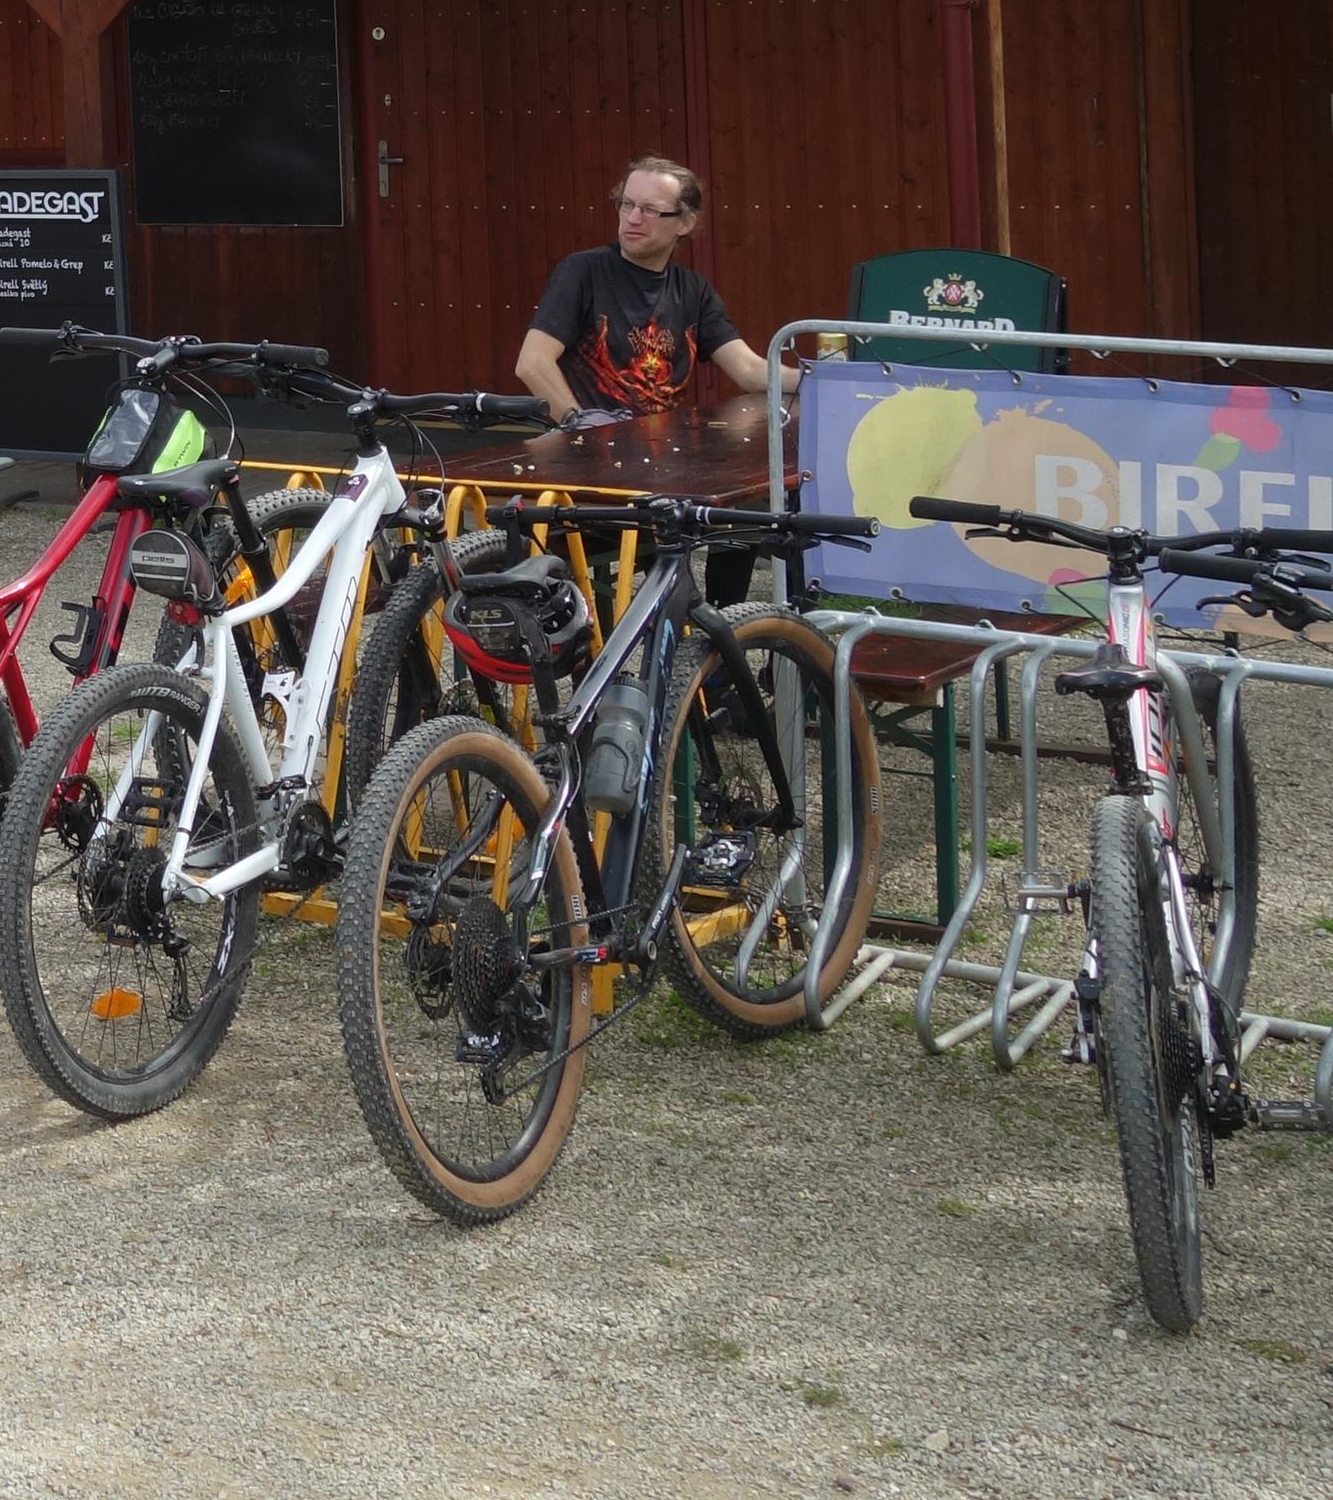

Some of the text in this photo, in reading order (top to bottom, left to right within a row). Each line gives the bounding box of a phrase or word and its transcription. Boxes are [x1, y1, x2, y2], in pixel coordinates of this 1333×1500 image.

[20, 238, 31, 248] 10
[102, 233, 113, 243] Kč
[21, 258, 53, 269] Pomelo
[61, 258, 83, 275] Grep
[103, 259, 115, 270] Kč
[105, 286, 115, 296] Kč
